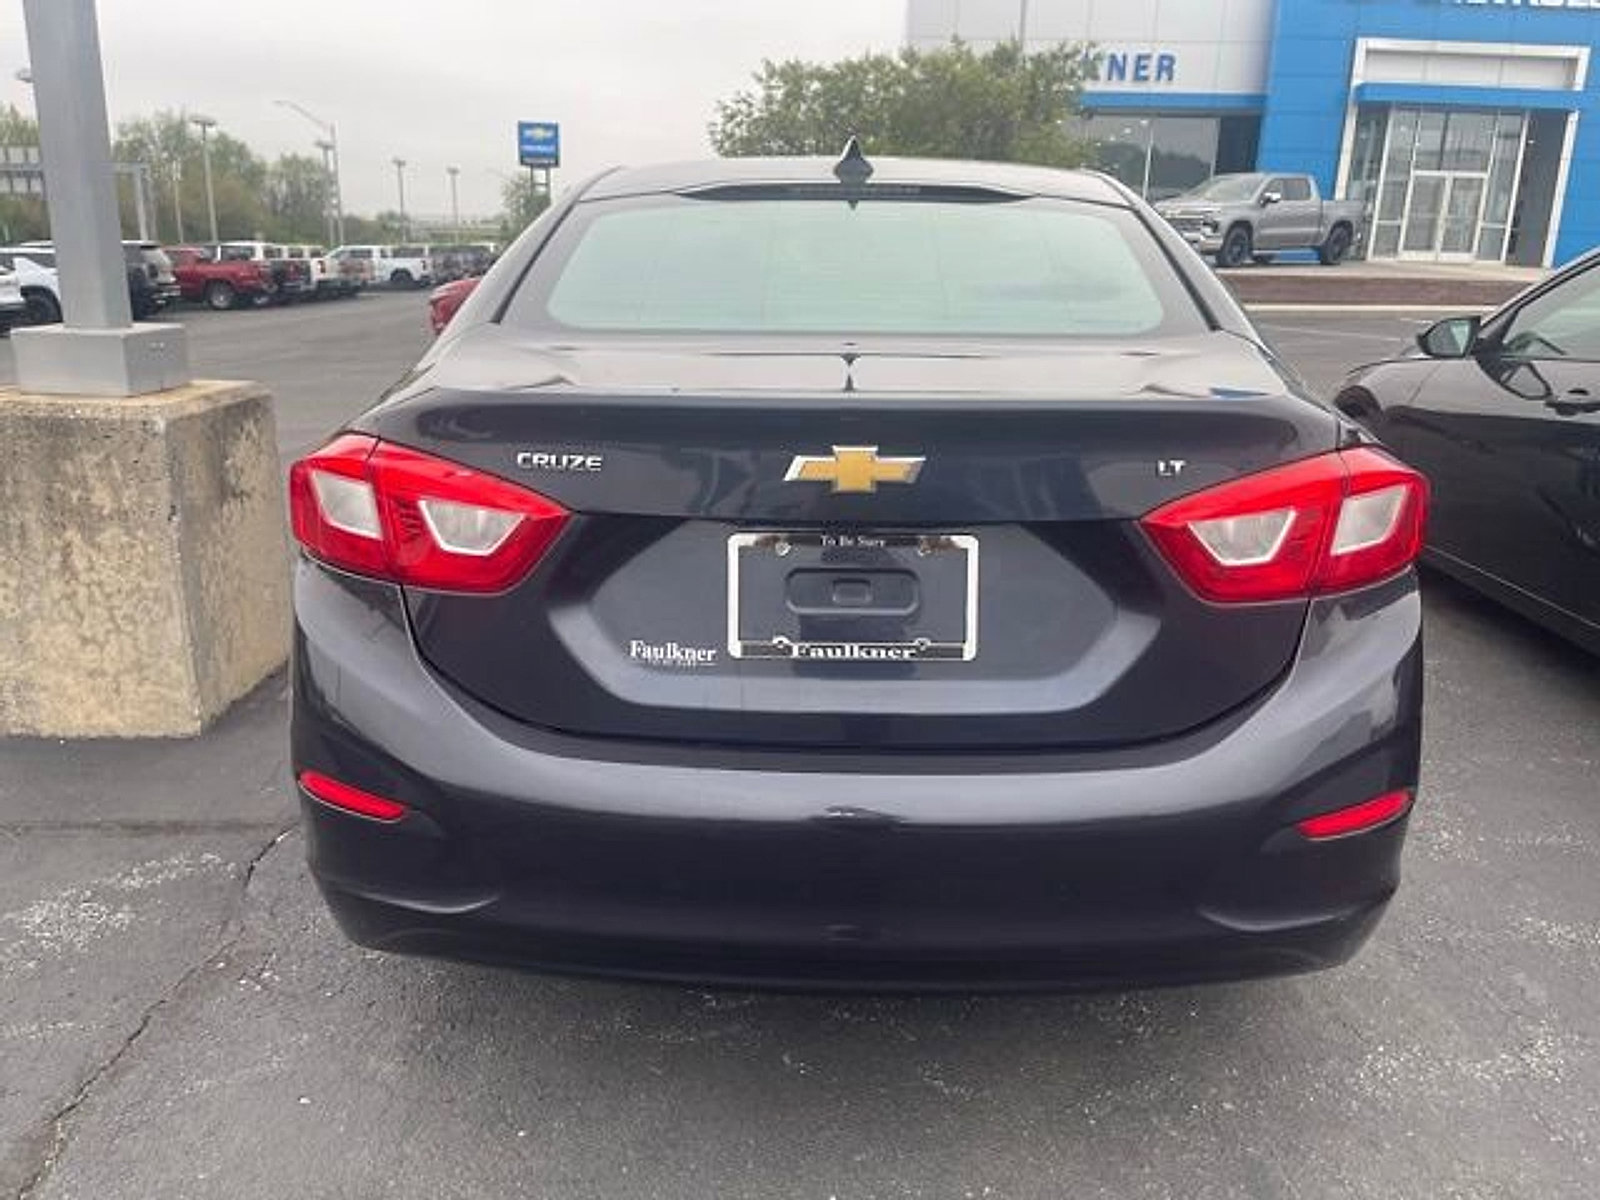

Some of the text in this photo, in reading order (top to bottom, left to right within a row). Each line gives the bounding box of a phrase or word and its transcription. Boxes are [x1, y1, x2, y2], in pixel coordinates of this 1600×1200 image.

[517, 451, 603, 472] CRUZE
[1157, 459, 1187, 477] LT
[629, 639, 717, 662] Faulkner
[790, 643, 917, 659] Faulkner
